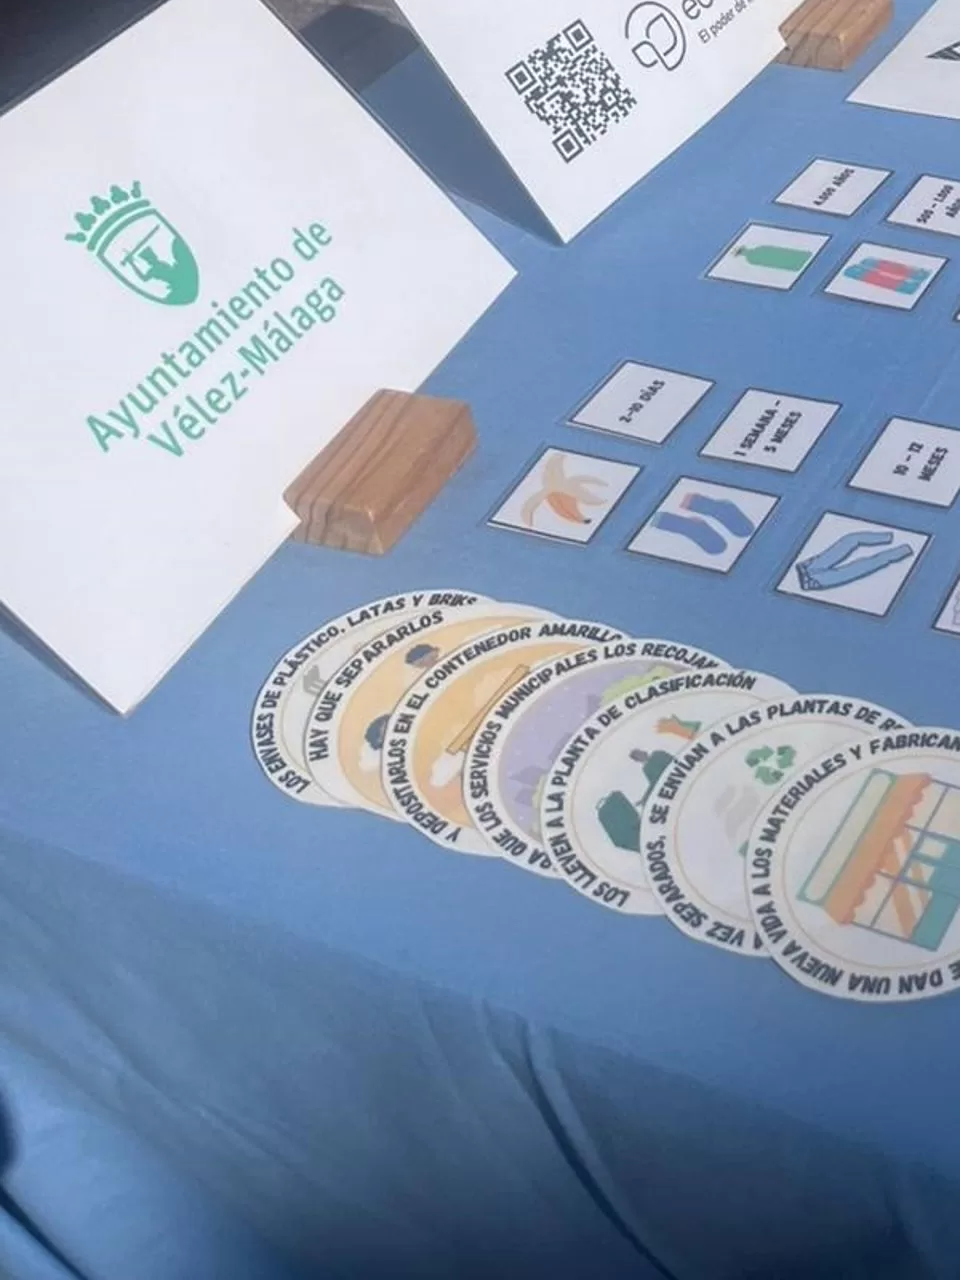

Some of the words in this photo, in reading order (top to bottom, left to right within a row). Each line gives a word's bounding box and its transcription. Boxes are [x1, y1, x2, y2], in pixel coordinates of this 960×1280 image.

[698, 28, 712, 43] El
[709, 9, 735, 37] poder
[734, 0, 747, 13] de
[86, 255, 295, 453] Ayuntamiento
[293, 219, 333, 261] de
[148, 274, 345, 458] Vélez-Málaga
[639, 379, 666, 402] DÍAS
[740, 408, 778, 450] SEMANA
[770, 410, 803, 444] MESES
[917, 446, 949, 482] MESES
[347, 597, 406, 627] LATAS
[411, 593, 425, 607] Y
[335, 610, 444, 688] SEPARARLOS
[425, 627, 533, 688] CONTENEDOR
[604, 642, 636, 659] LOS
[496, 648, 599, 720] MUNICIPALES
[624, 670, 757, 709] CLASIFICACIÓN
[261, 690, 281, 709] DE
[314, 690, 343, 723] QUE
[406, 691, 430, 710] EL
[767, 699, 853, 720] PLANTAS
[393, 713, 415, 734] EN
[600, 705, 623, 727] DE
[724, 710, 763, 737] LAS
[854, 705, 882, 725] DE
[256, 714, 286, 775] ENVASES
[308, 728, 330, 762] HAY
[709, 733, 726, 748] A
[849, 744, 863, 760] Y
[470, 721, 502, 801] SERVICIOS
[551, 728, 600, 787] PLANTA
[657, 743, 711, 801] ENVÍAN
[278, 768, 311, 794] LOS
[387, 738, 449, 835] DEPOSITARLOS
[545, 794, 564, 814] LA
[759, 753, 847, 844] MATERIALES
[474, 802, 502, 833] LOS
[546, 816, 564, 829] A
[650, 804, 670, 825] SE
[445, 827, 461, 843] Y
[491, 828, 529, 857] QUE
[548, 832, 597, 889] LLEVEN
[751, 843, 773, 880] LOS
[593, 881, 631, 908] LOS
[752, 884, 771, 897] A
[705, 920, 745, 948] VEZ
[756, 900, 788, 944] VIDA
[781, 943, 845, 986] NUEVA
[847, 972, 892, 995] UNA
[897, 971, 944, 996] DAN
